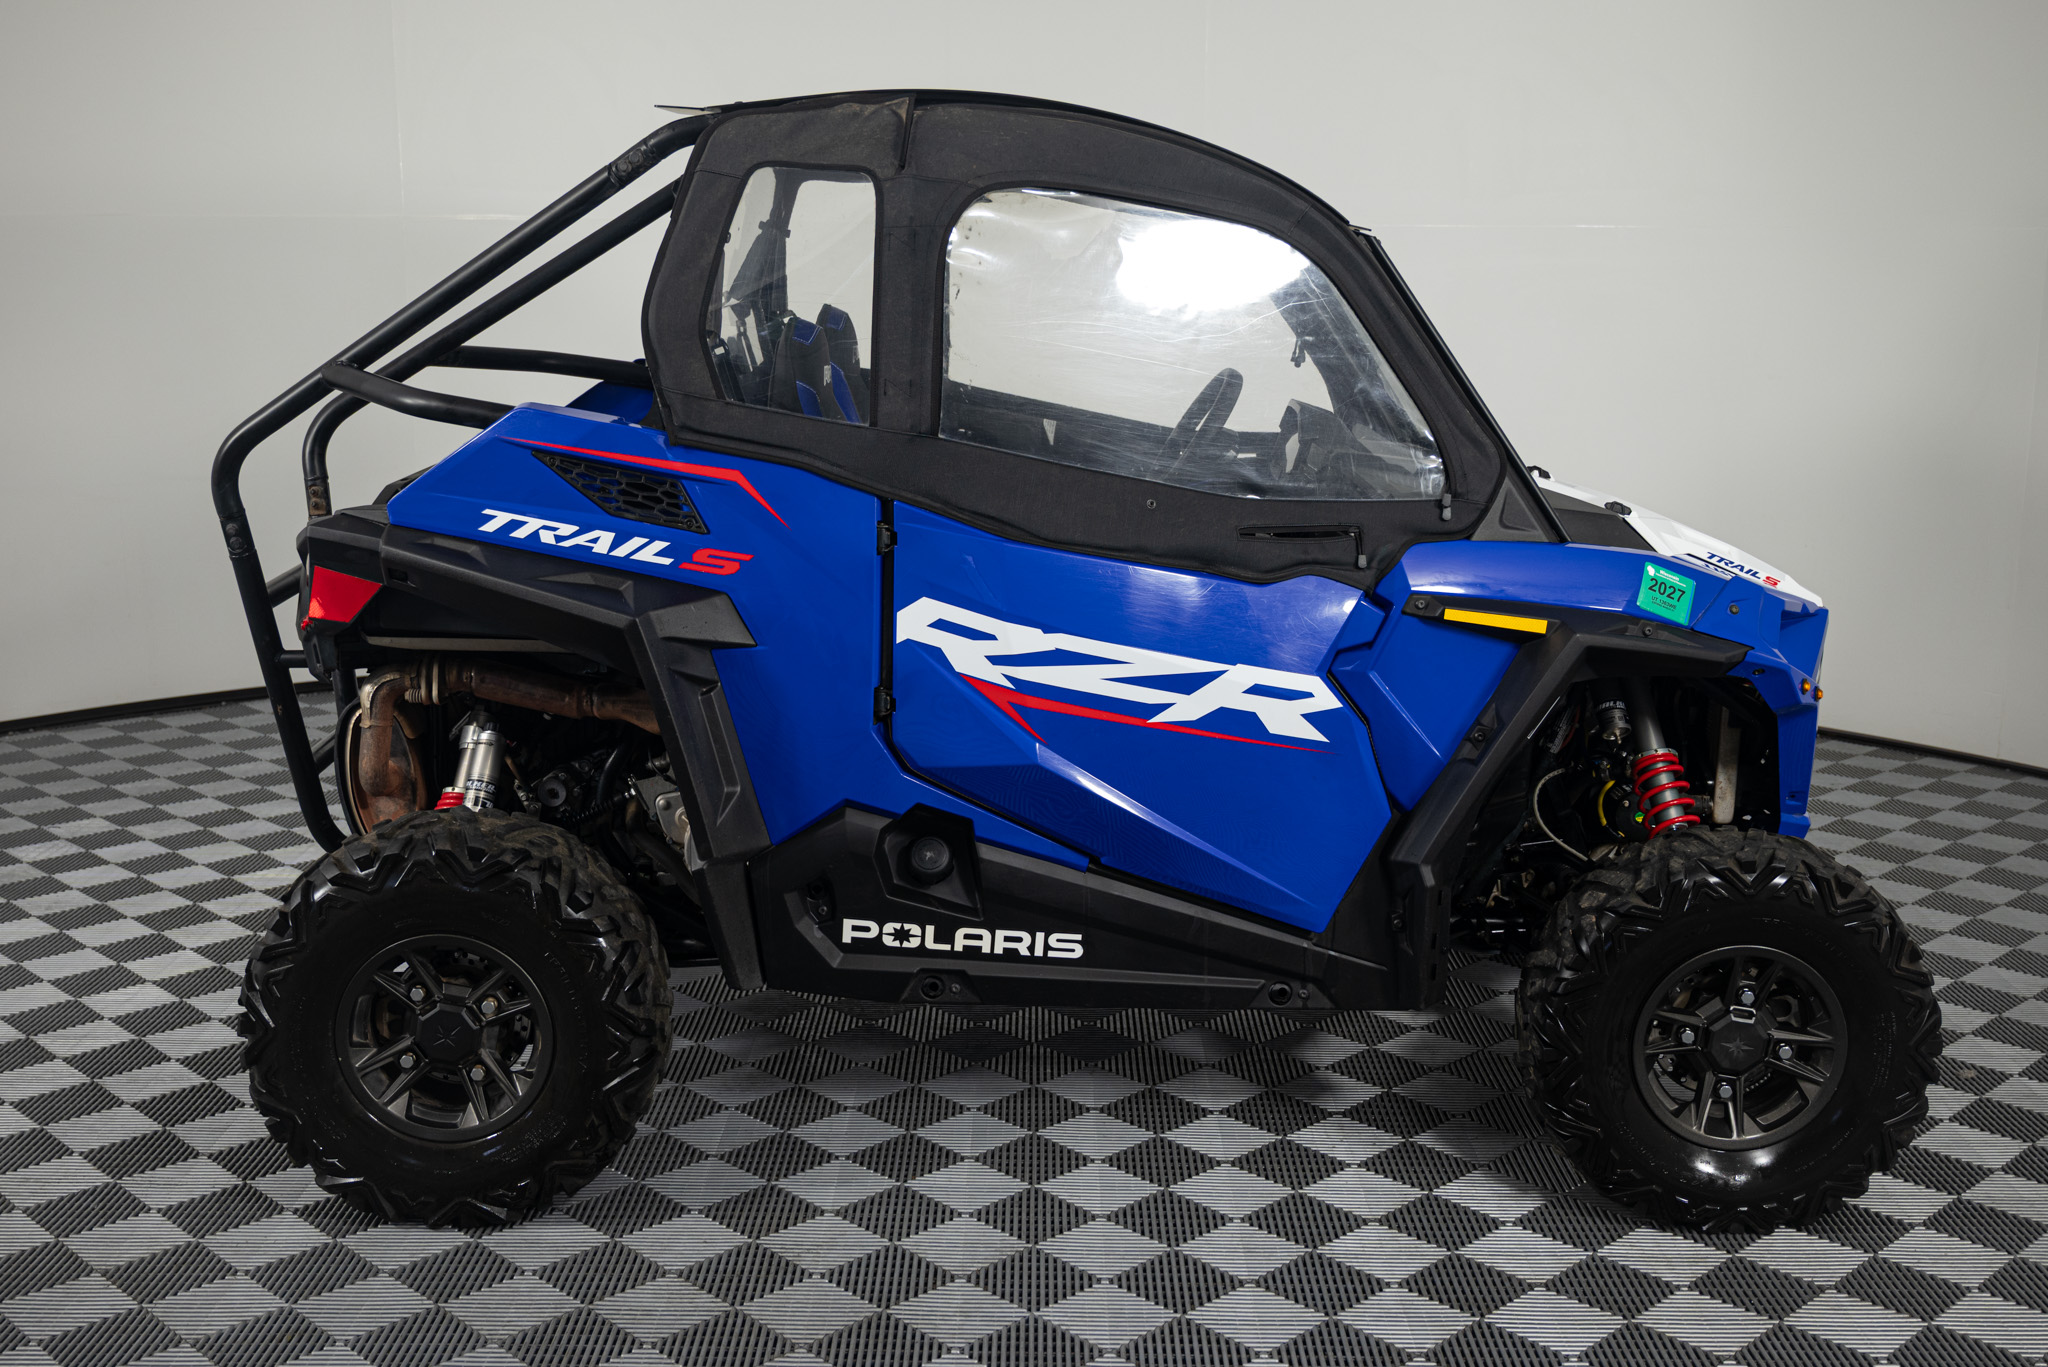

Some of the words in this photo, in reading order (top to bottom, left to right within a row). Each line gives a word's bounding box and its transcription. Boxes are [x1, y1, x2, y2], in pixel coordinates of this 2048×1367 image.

[477, 508, 674, 565] TRAIL
[678, 548, 755, 576] S
[1647, 577, 1686, 603] 2027
[1706, 551, 1762, 580] TRAIL
[1762, 575, 1781, 588] S
[896, 596, 1343, 743] RZR
[841, 918, 1084, 959] POLARIS
